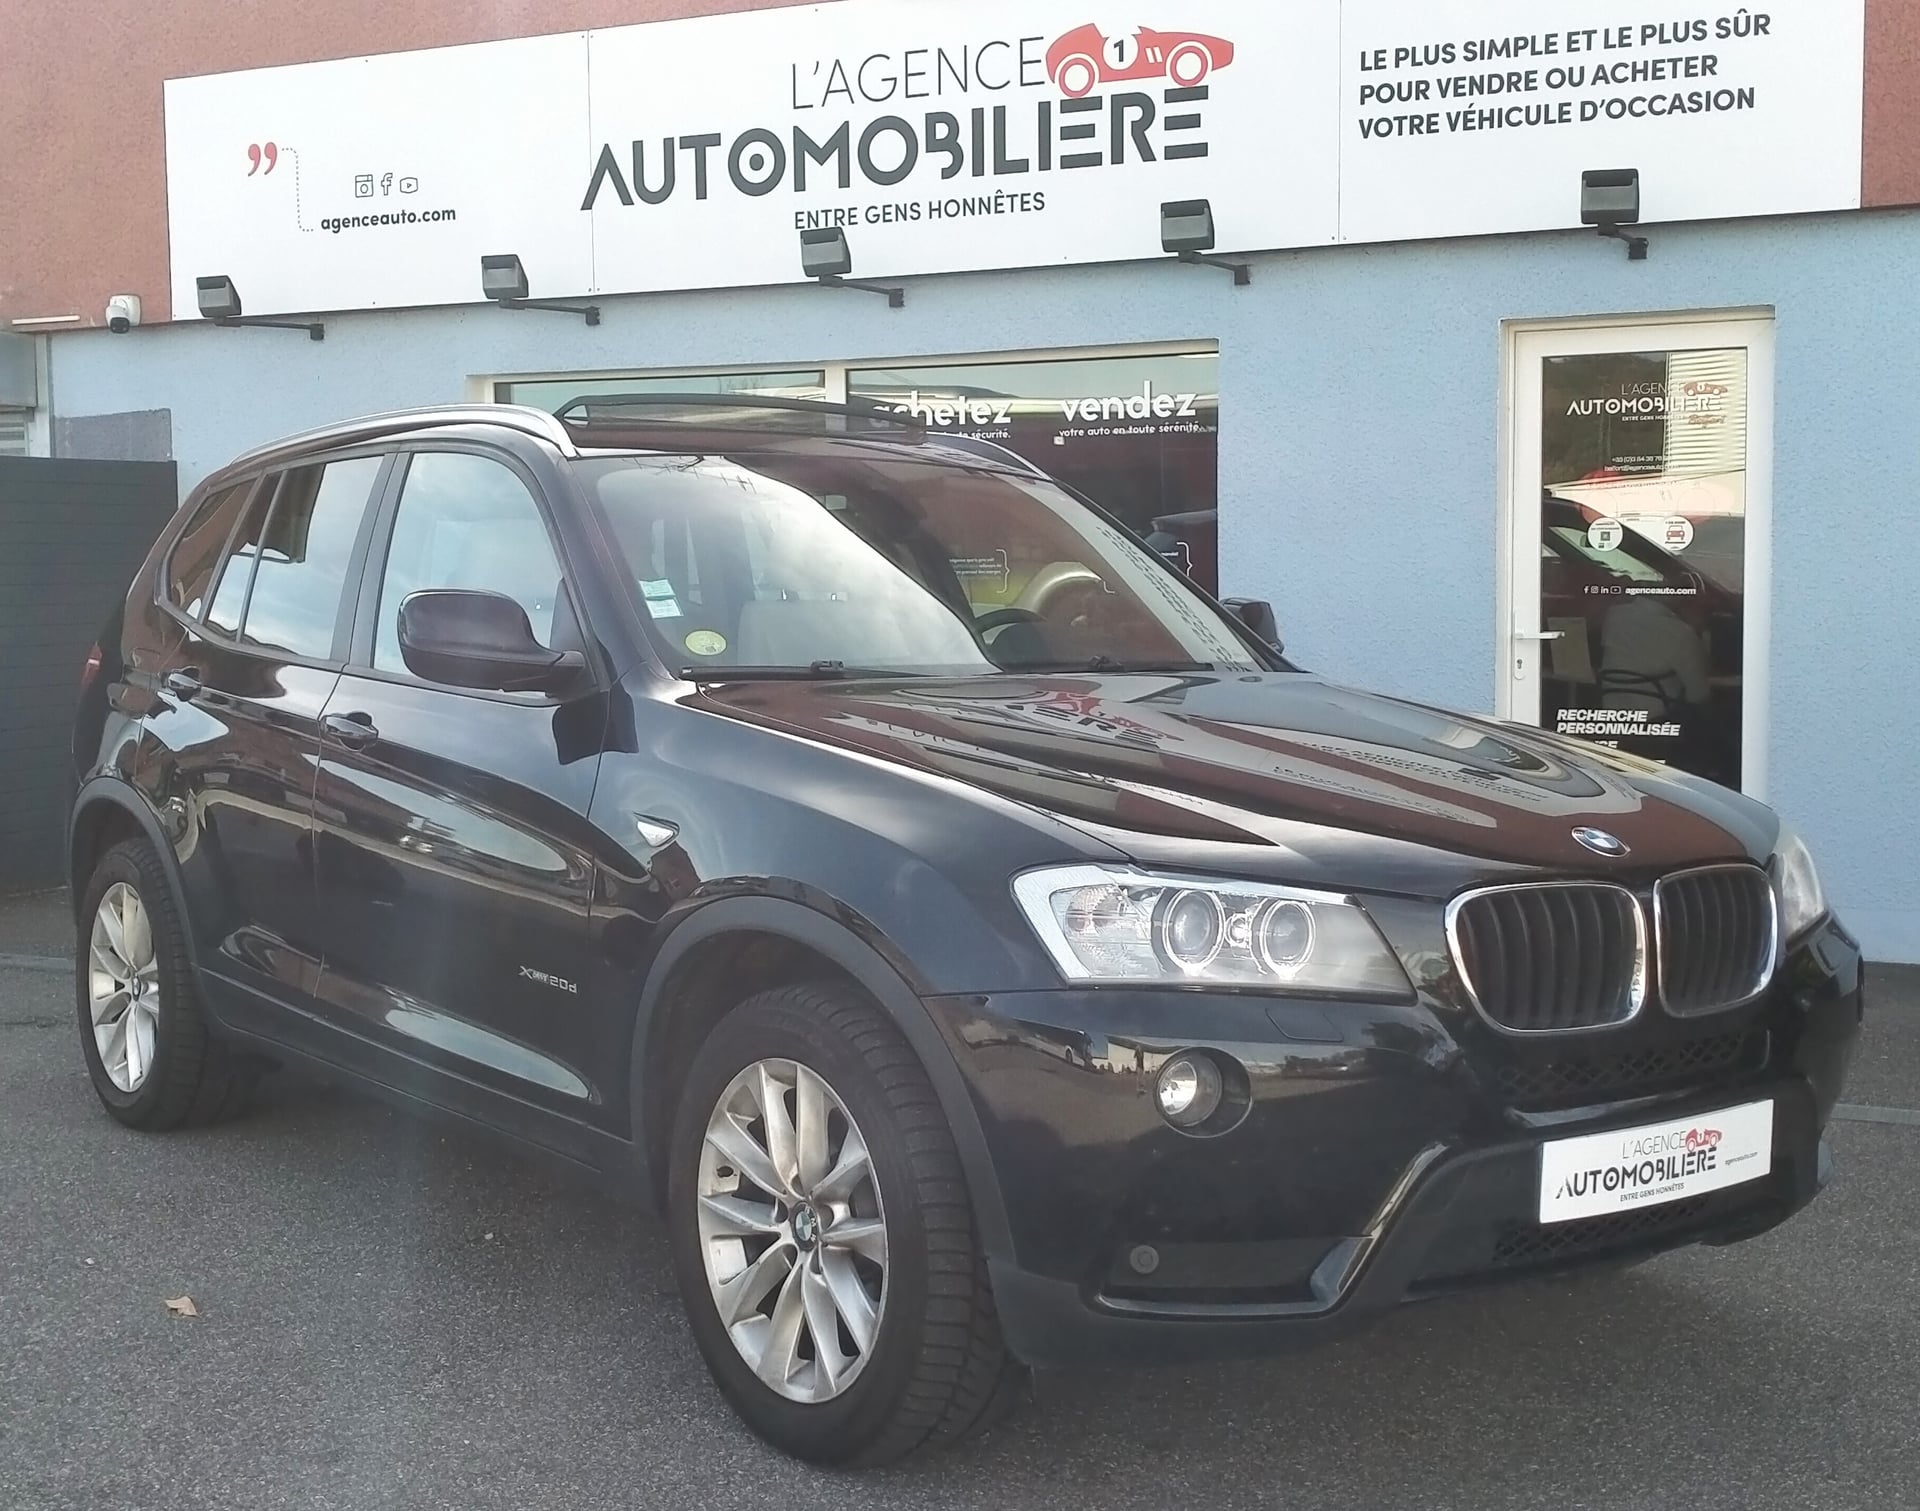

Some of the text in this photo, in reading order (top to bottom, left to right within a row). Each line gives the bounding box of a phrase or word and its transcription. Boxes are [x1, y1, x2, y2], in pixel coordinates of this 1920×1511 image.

[1113, 39, 1124, 62] 1
[1360, 8, 1771, 72] LE PLUS SIMPLE ET LE PLUS SÛR
[1360, 54, 1719, 106] POUR VENDRE OU ACHETER
[1359, 111, 1440, 139] VOTRE
[1446, 97, 1572, 132] VÉHICULE
[320, 208, 456, 234] agenceauto.com
[795, 189, 1045, 230] ENTRE GENS HONNÊTES
[873, 390, 1013, 426] hetez
[1060, 380, 1198, 422] vendez
[1058, 428, 1084, 438] votre
[1087, 426, 1110, 437] auto
[1128, 425, 1156, 435] toute
[1625, 586, 1697, 596] agenceauto.com
[1557, 709, 1648, 722] RECHERCHE
[1557, 722, 1681, 737] PERSONNALISÉE
[1620, 1191, 1639, 1202] ENTRE
